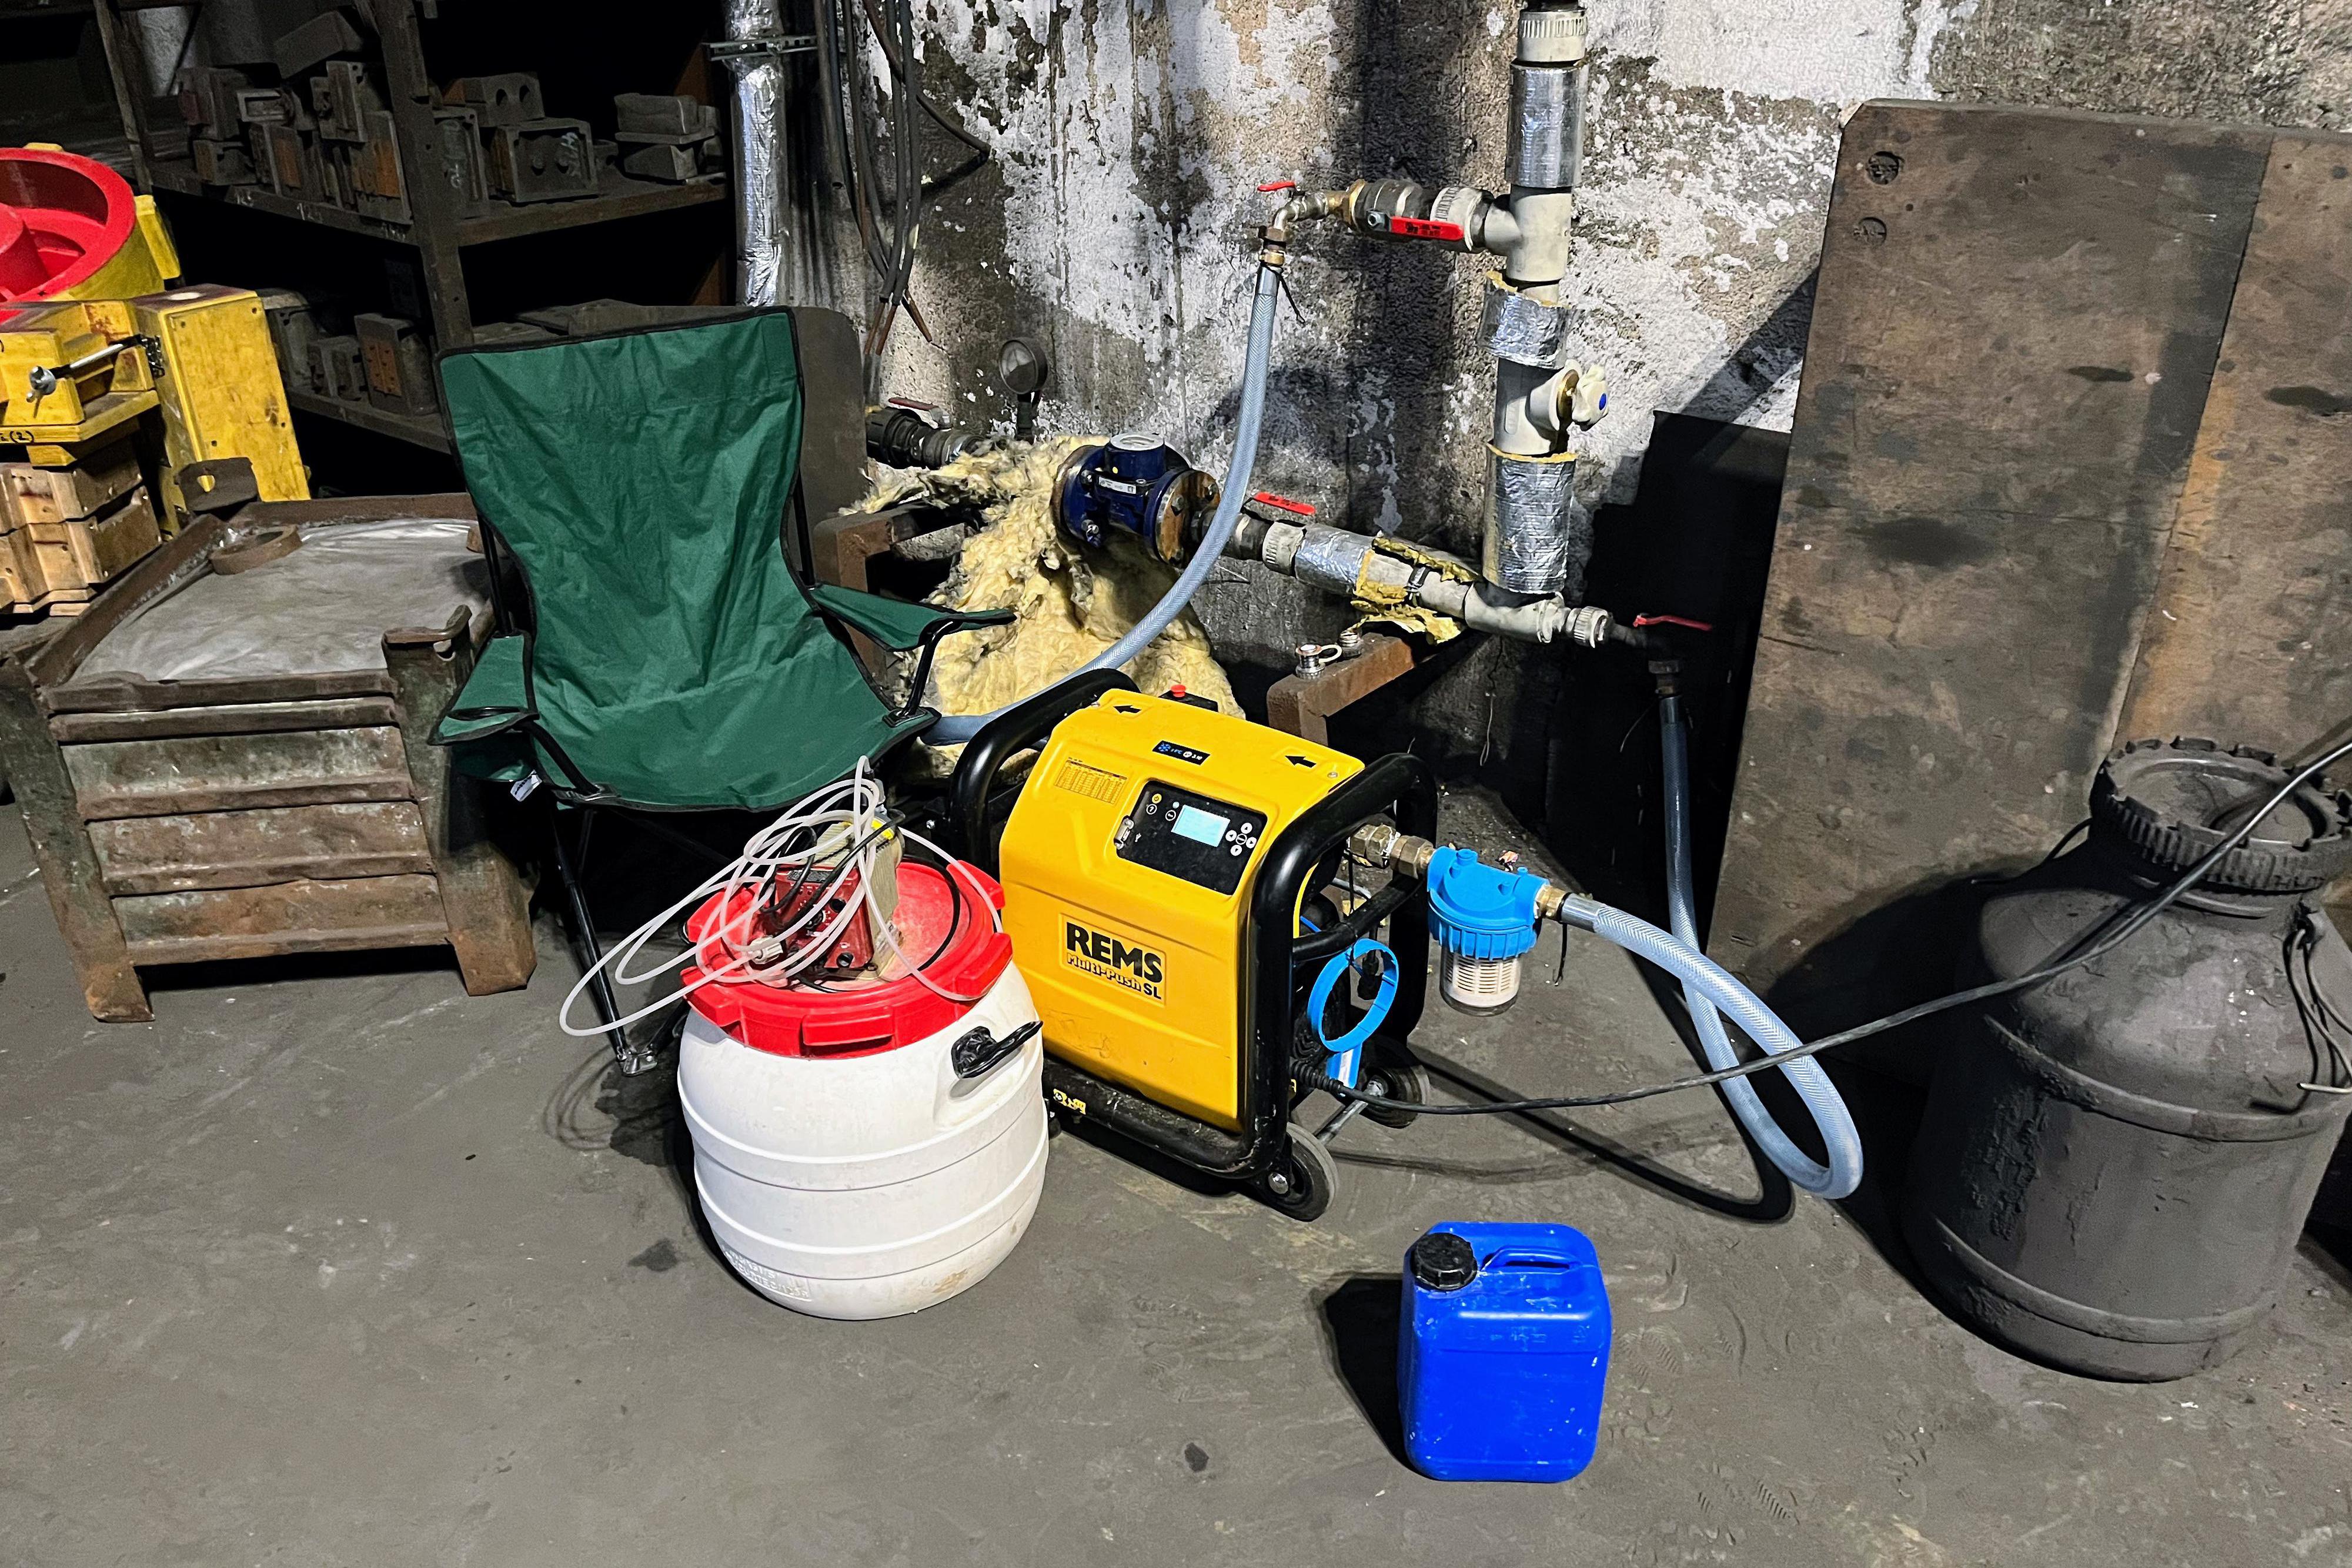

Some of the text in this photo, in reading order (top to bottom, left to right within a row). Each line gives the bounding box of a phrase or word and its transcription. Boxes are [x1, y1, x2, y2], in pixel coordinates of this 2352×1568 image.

[1067, 922, 1162, 983] REMS
[1067, 952, 1162, 1000] Multi-Push SL
